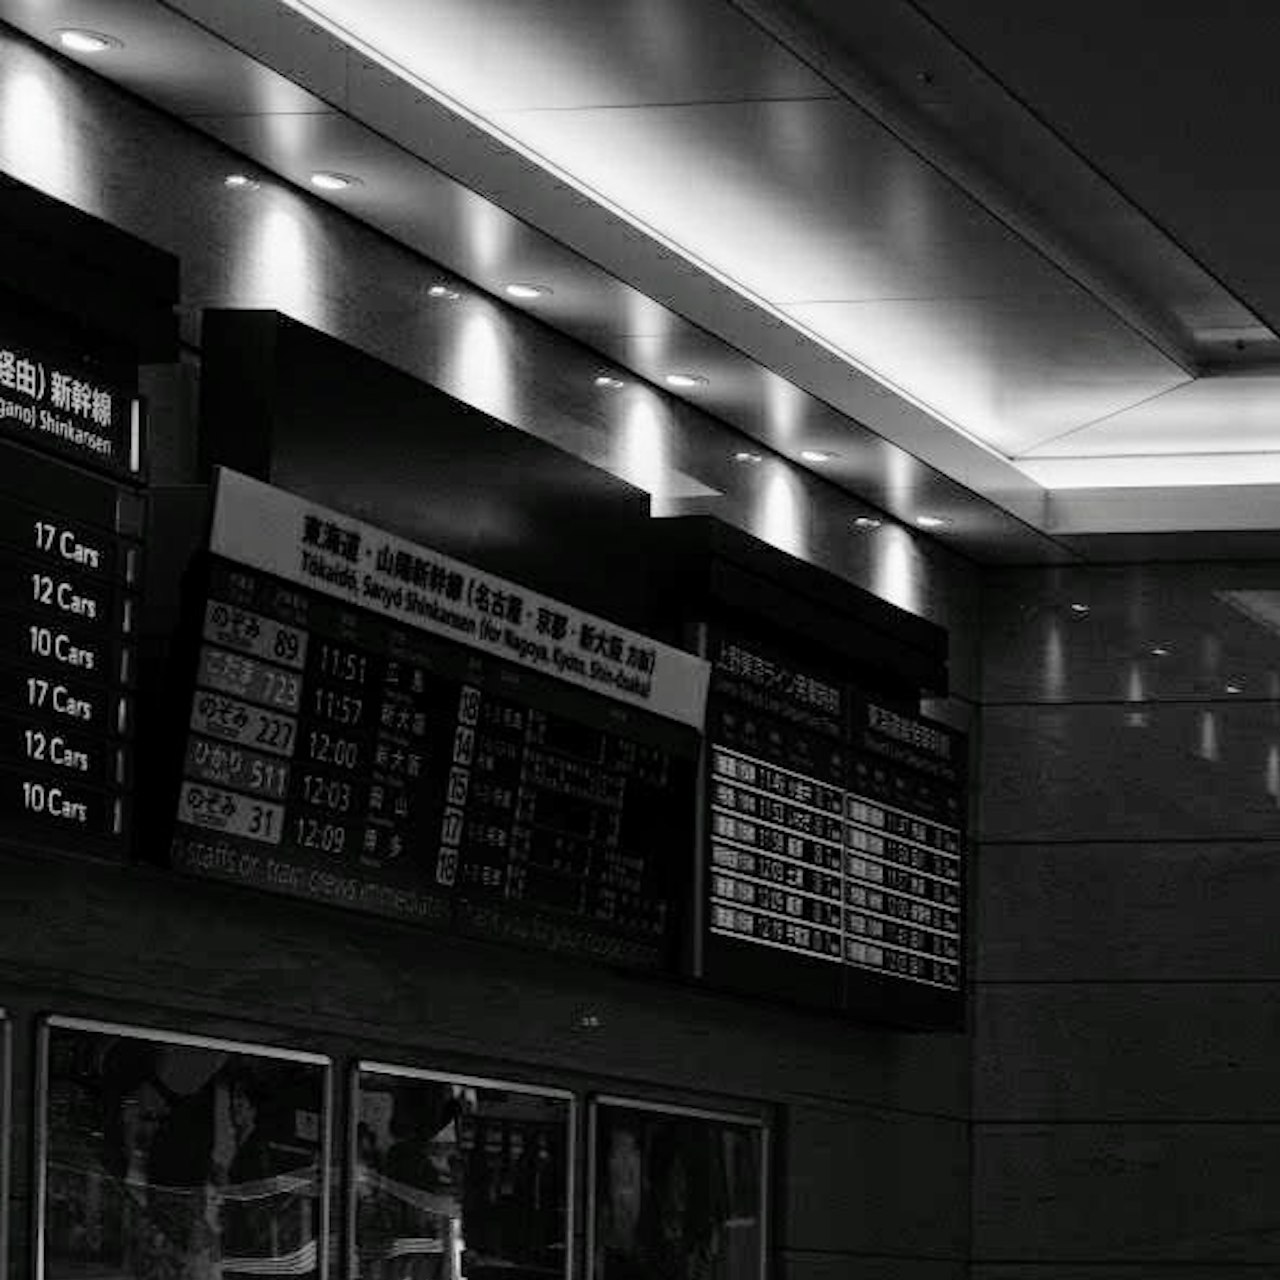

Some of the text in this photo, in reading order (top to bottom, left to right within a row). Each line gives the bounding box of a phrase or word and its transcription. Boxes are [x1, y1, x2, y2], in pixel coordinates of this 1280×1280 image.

[39, 410, 112, 457] Shinkansen
[34, 521, 100, 569] 17 Cars
[32, 574, 97, 619] 12 Cars
[29, 625, 94, 670] 10 Cars
[275, 630, 298, 660] 89
[321, 644, 366, 684] 11:51
[27, 678, 92, 722] 17 Cars
[314, 688, 362, 726] 11:57
[25, 730, 89, 773] 12 Cars
[257, 717, 292, 748] 227
[309, 731, 357, 770] 12:00
[22, 782, 88, 824] 10 Cars
[249, 759, 286, 797] 511
[303, 775, 351, 812] 12:03
[250, 806, 273, 836] 31
[296, 817, 345, 853] 12:09
